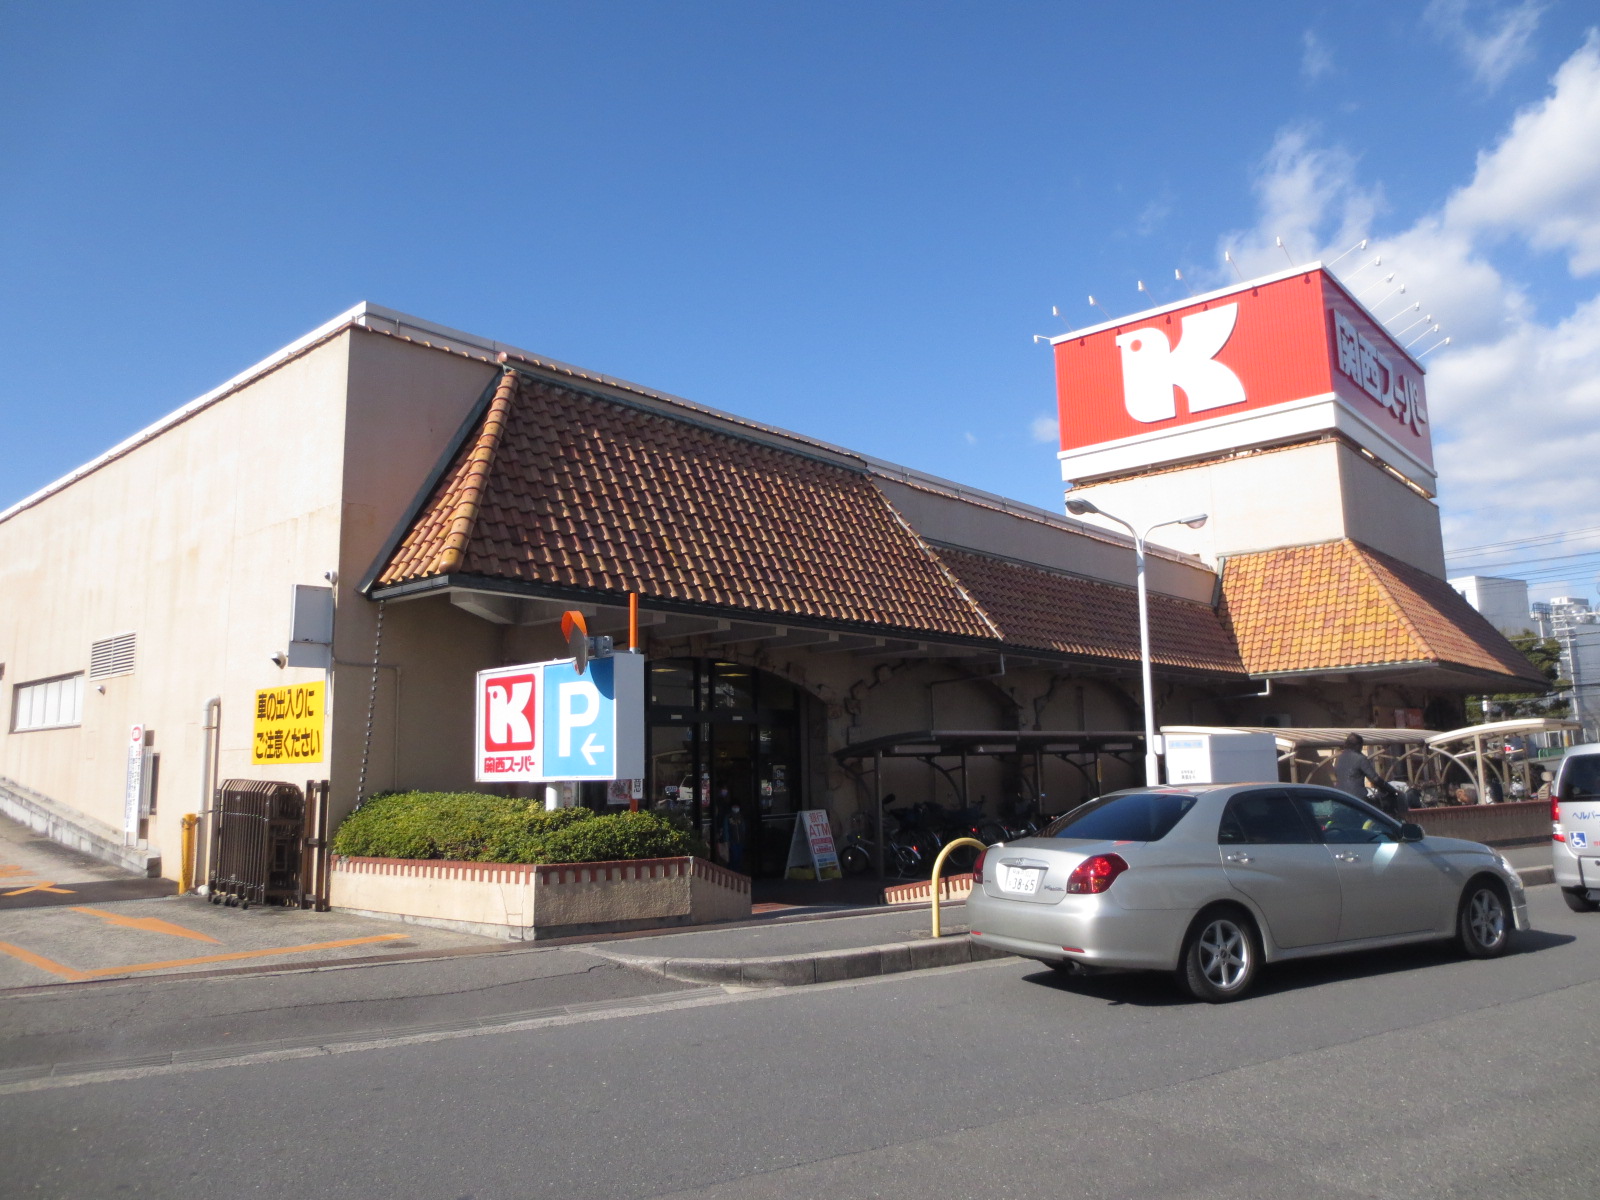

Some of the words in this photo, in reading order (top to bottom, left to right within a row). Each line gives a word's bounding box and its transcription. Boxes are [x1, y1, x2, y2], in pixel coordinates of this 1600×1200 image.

[1333, 308, 1427, 437] 関西スーパー
[256, 688, 316, 722] 車の出入りに
[558, 680, 600, 758] P
[255, 727, 321, 759] ご注意ください
[483, 755, 536, 774] 関西スーパー
[809, 823, 831, 838] ATM
[1012, 877, 1036, 892] 38-65
